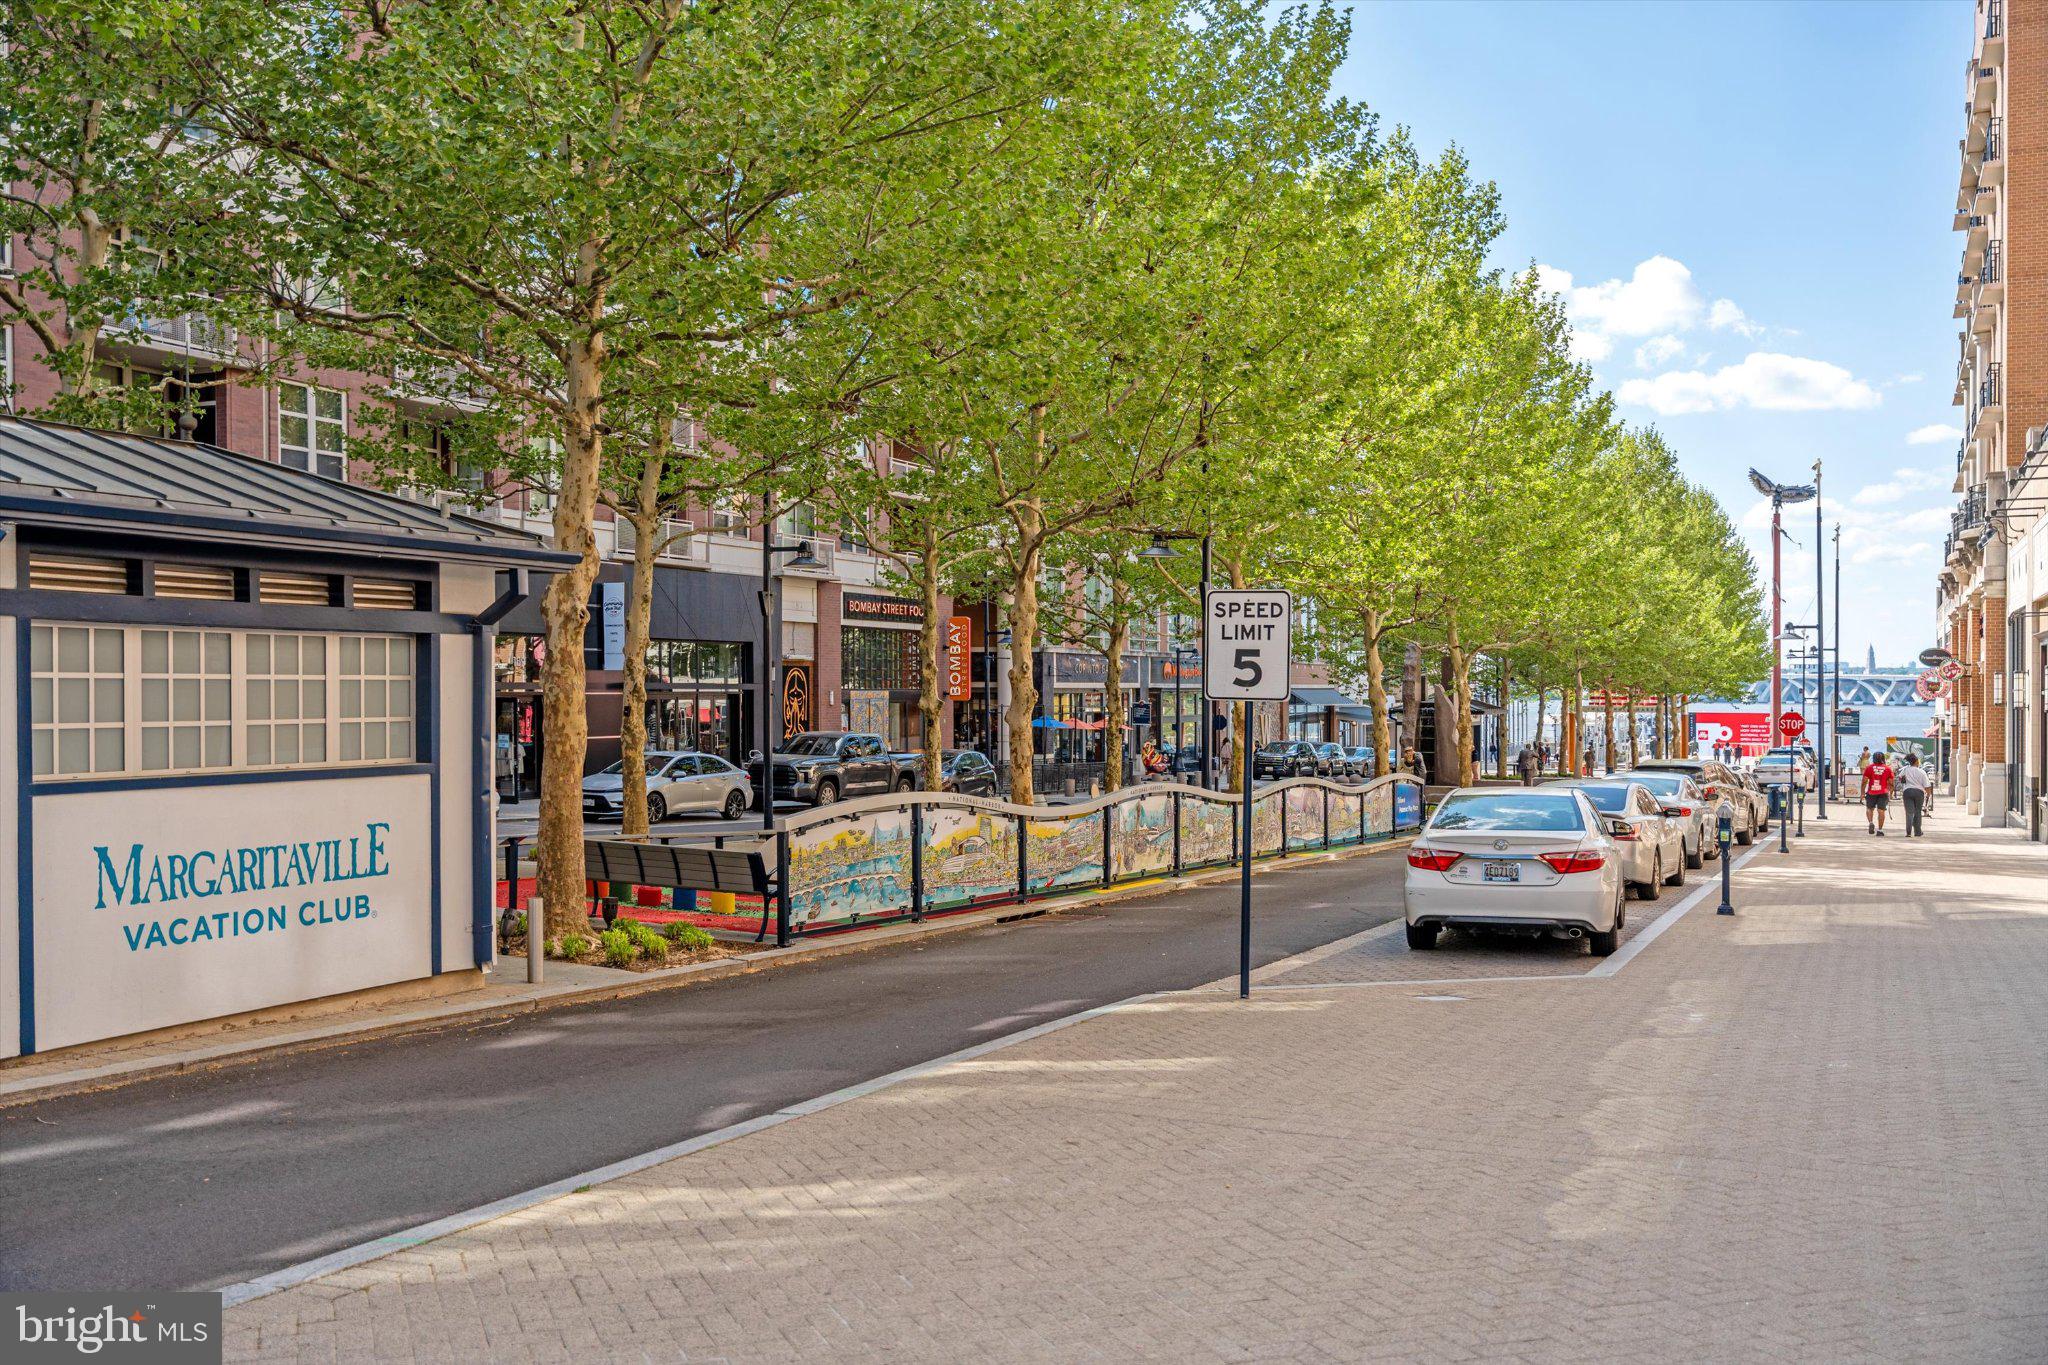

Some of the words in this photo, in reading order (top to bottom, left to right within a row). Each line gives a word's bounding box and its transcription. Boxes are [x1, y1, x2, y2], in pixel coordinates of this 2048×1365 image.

[849, 600, 881, 613] BOMBAY
[882, 603, 908, 615] STREET
[909, 605, 924, 617] FOO
[1214, 602, 1283, 618] SPEED
[1221, 624, 1275, 640] LIMIT
[949, 622, 961, 696] BOMBAY
[1232, 648, 1262, 687] 5
[1779, 720, 1804, 730] STOP
[93, 822, 390, 910] MARGARITAVILLE
[123, 905, 287, 952] VACATION
